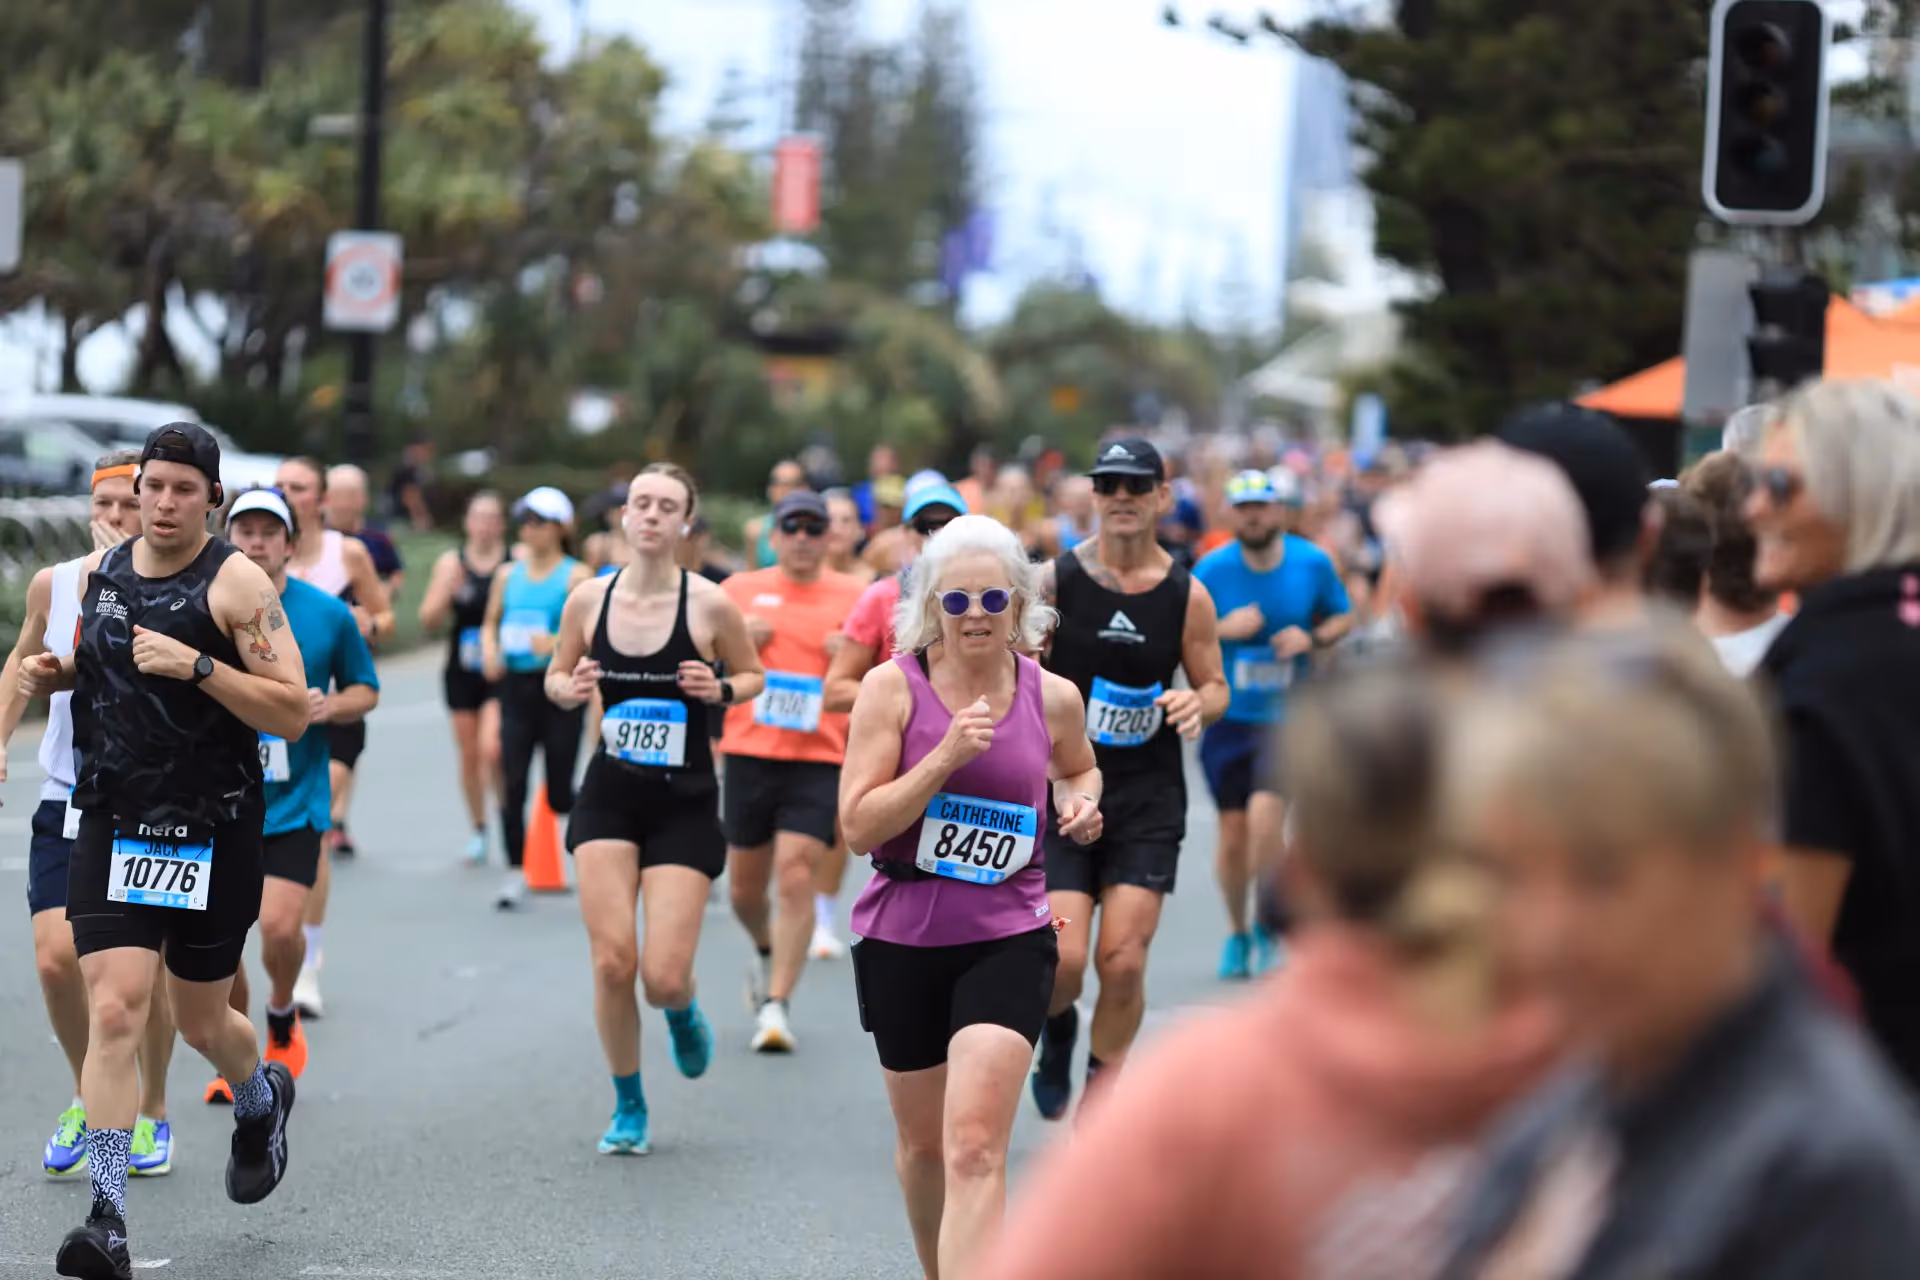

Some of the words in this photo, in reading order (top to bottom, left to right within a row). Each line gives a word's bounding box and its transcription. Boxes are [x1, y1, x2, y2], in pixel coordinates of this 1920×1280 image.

[1098, 706, 1155, 734] 11203
[616, 721, 670, 750] 9183
[940, 802, 1025, 833] CATHERINE
[144, 840, 180, 858] JACK
[934, 823, 1017, 870] 8450
[123, 856, 200, 894] 10776
